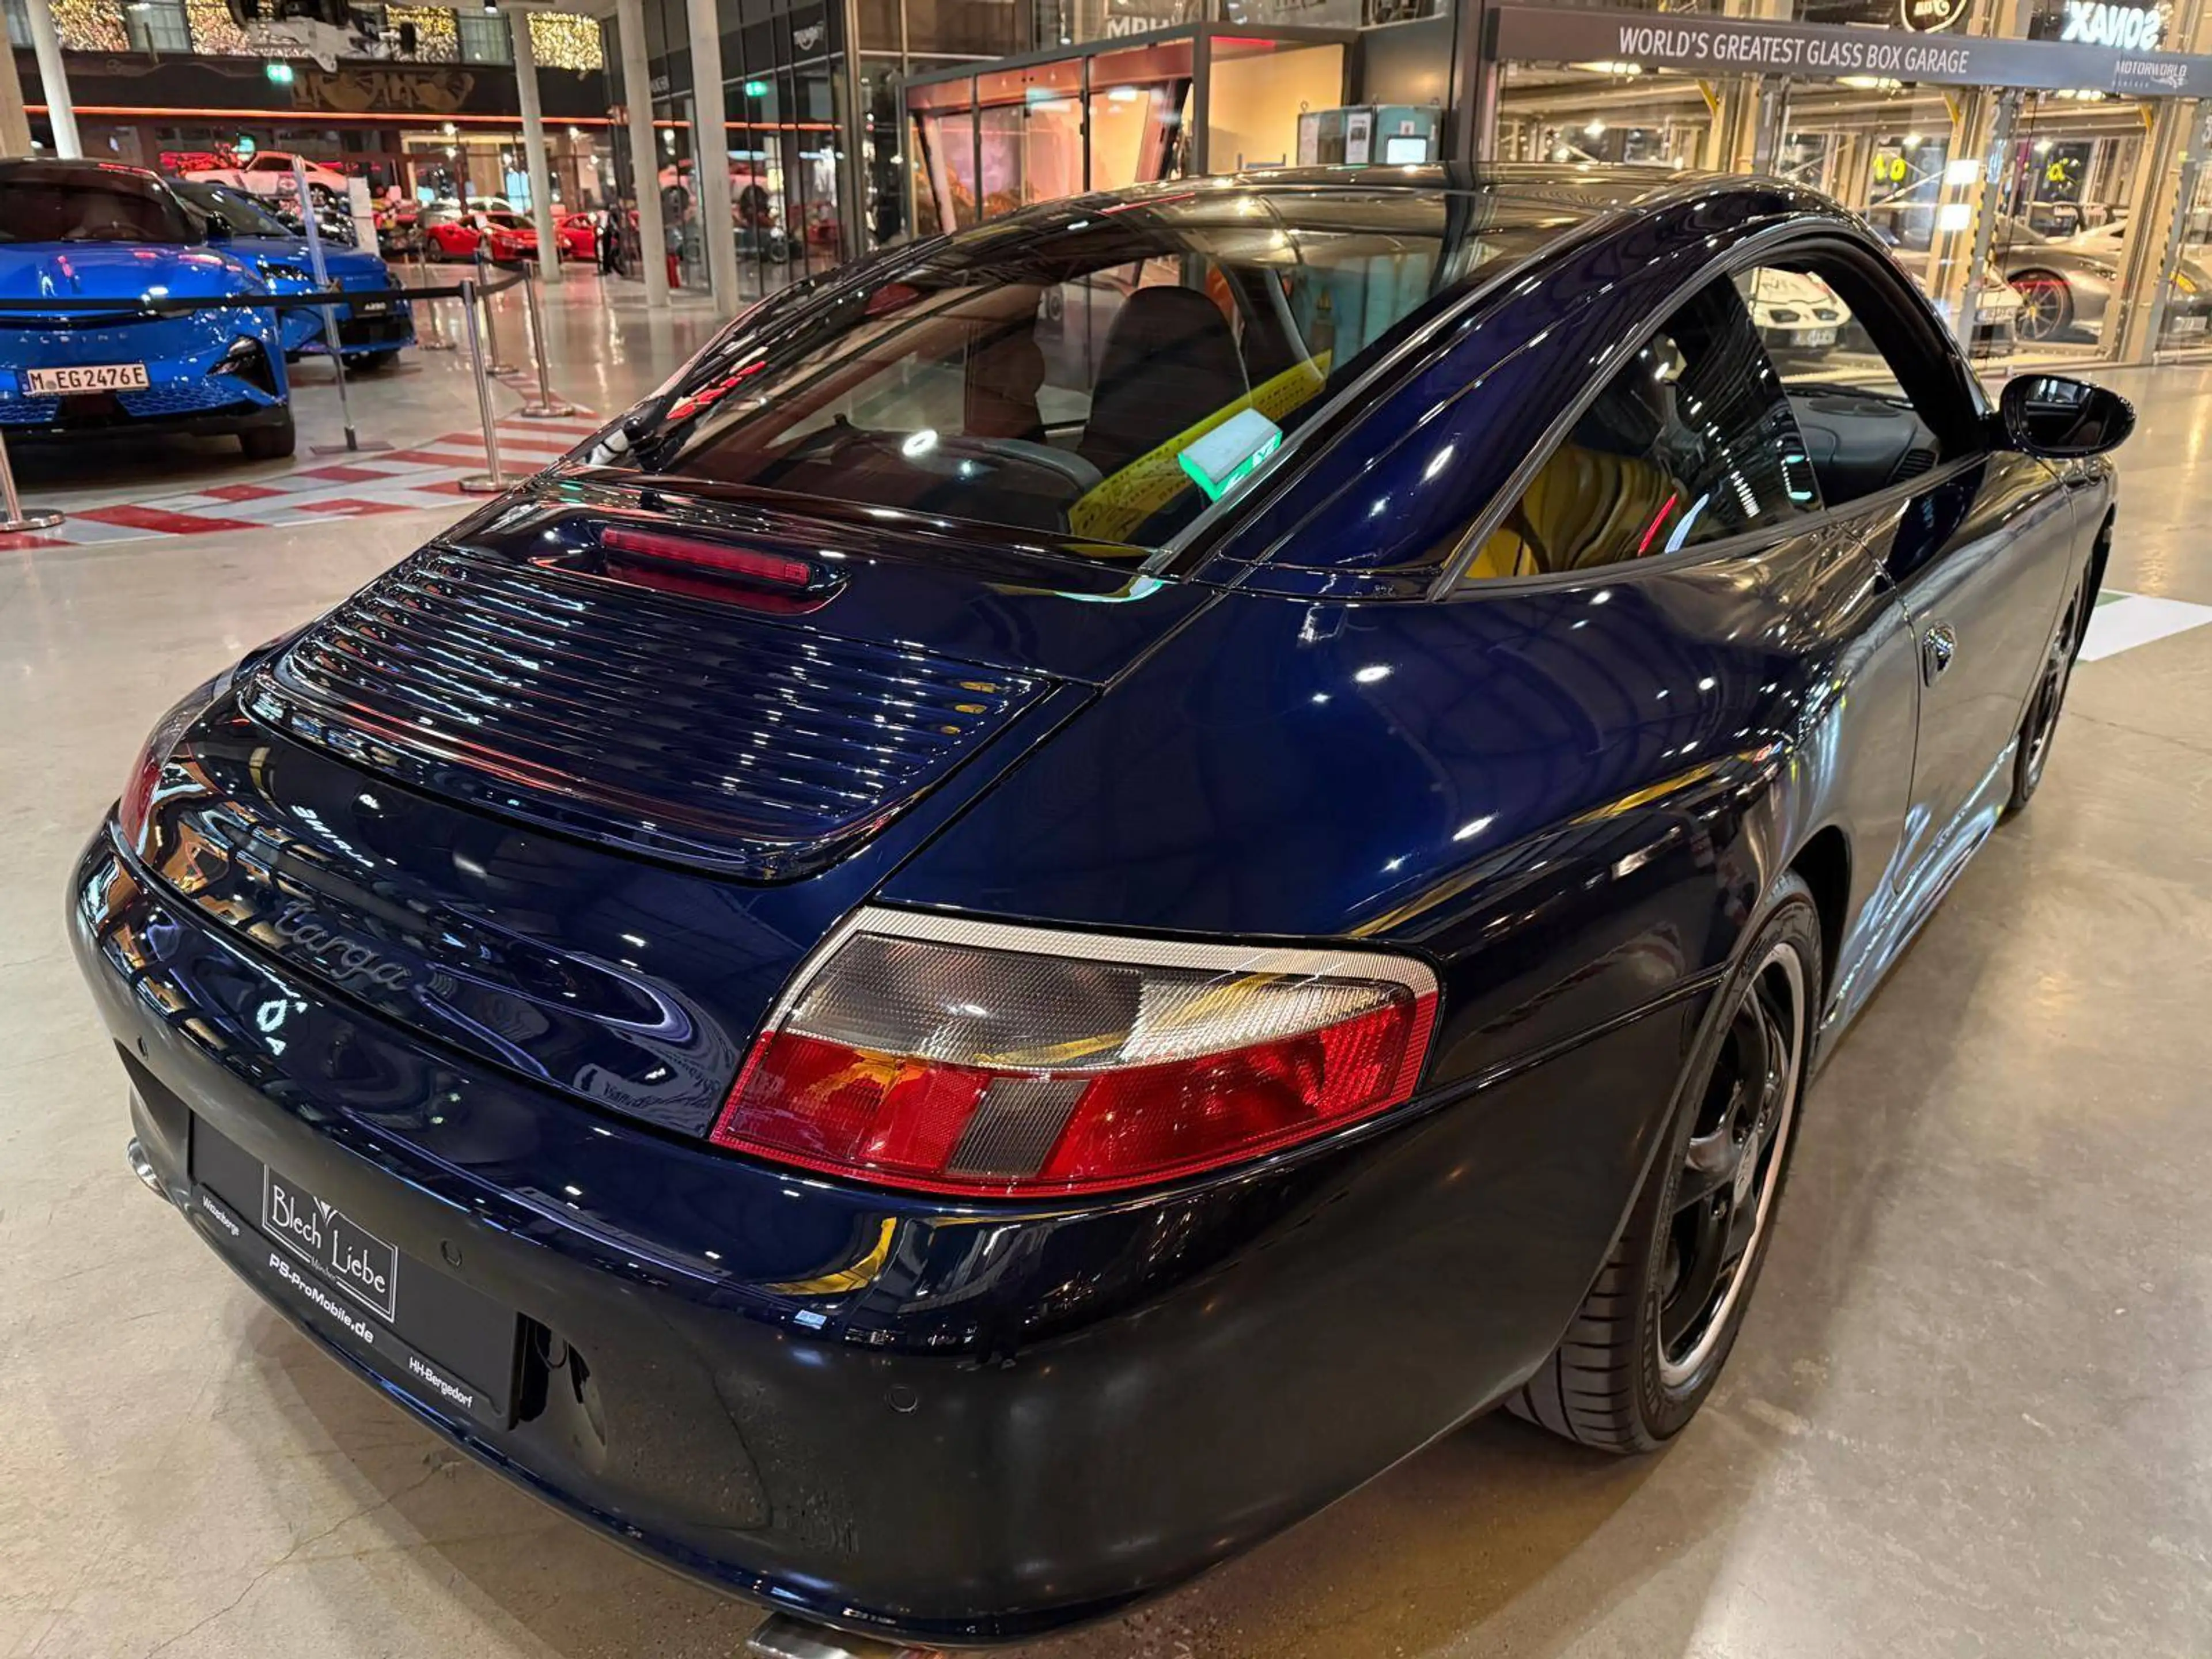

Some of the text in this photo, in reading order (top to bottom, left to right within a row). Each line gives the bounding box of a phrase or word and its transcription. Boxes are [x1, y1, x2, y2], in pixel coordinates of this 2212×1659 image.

[1619, 26, 1970, 73] WORLD'S GREATEST GLASS BOX GARAGE
[2115, 60, 2188, 77] MOTORWORLD
[272, 1184, 385, 1294] Blech Liebe
[269, 1252, 374, 1344] PS-ProMobile.de
[409, 1356, 473, 1408] HH-Bergedorf
